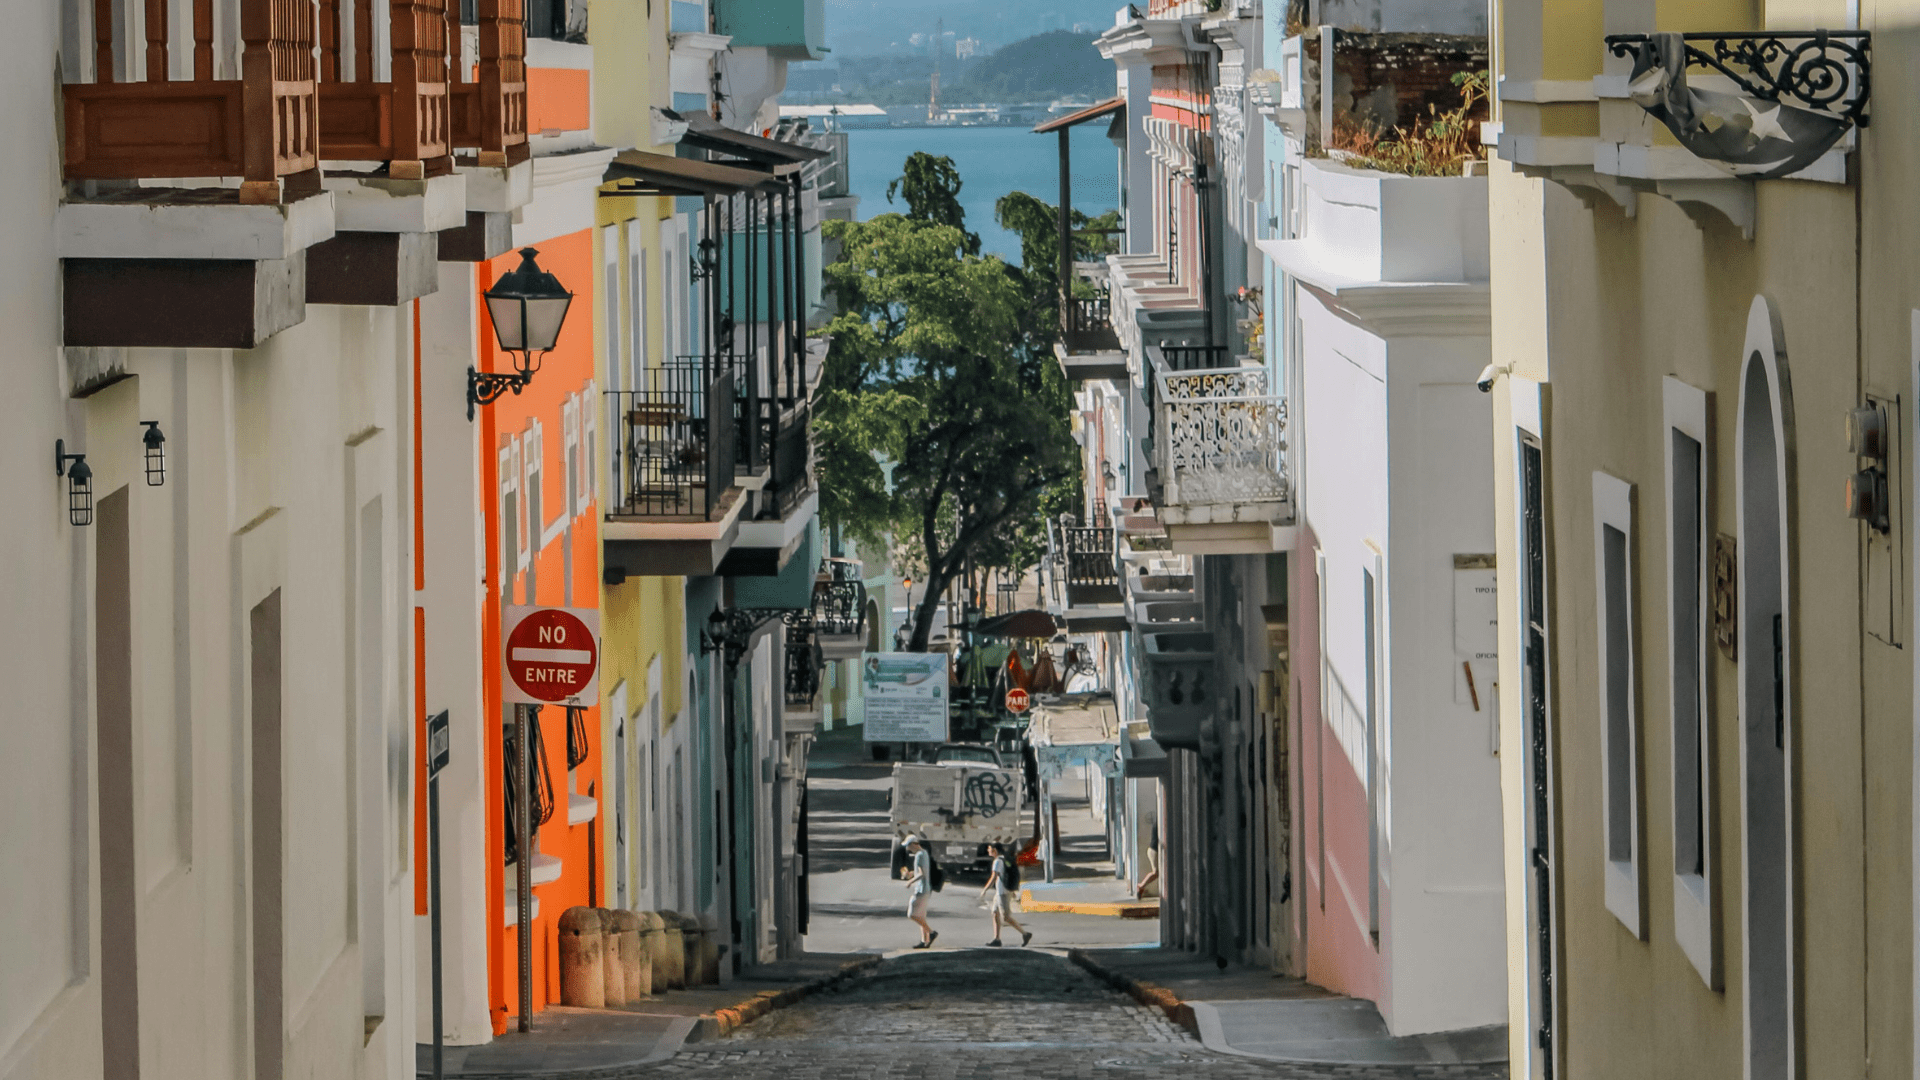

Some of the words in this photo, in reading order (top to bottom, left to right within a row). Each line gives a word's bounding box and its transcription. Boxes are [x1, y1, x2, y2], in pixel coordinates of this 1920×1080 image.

[539, 626, 566, 644] NO
[525, 667, 577, 684] ENTRE
[1007, 696, 1027, 705] PARE
